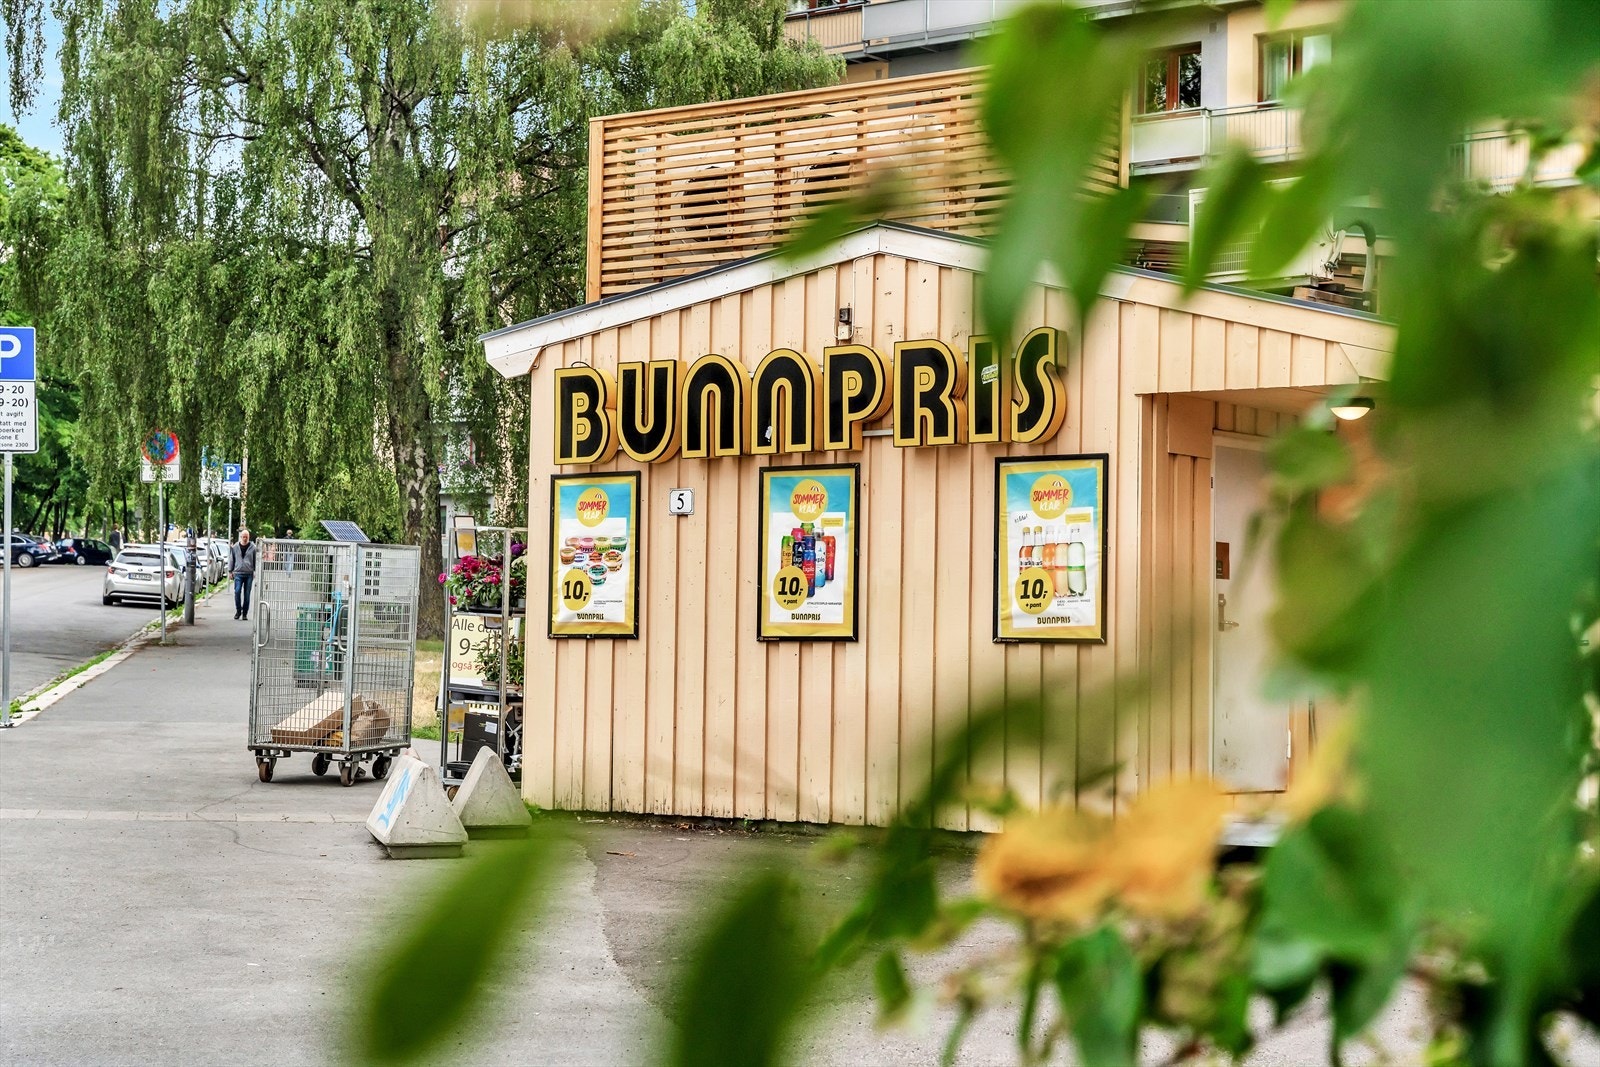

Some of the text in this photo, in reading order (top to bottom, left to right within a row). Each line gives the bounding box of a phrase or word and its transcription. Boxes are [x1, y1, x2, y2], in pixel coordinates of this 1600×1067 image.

[554, 326, 1067, 466] BUNNPRIS
[226, 465, 237, 481] P
[676, 492, 685, 510] 5
[793, 493, 826, 509] SOMMER
[1032, 488, 1069, 505] SOMMER
[578, 500, 607, 515] SOMMER
[791, 613, 821, 621] BUNNPRIS
[1037, 616, 1071, 625] BUNNPRIS
[452, 618, 475, 632] Alle
[452, 661, 473, 671] også
